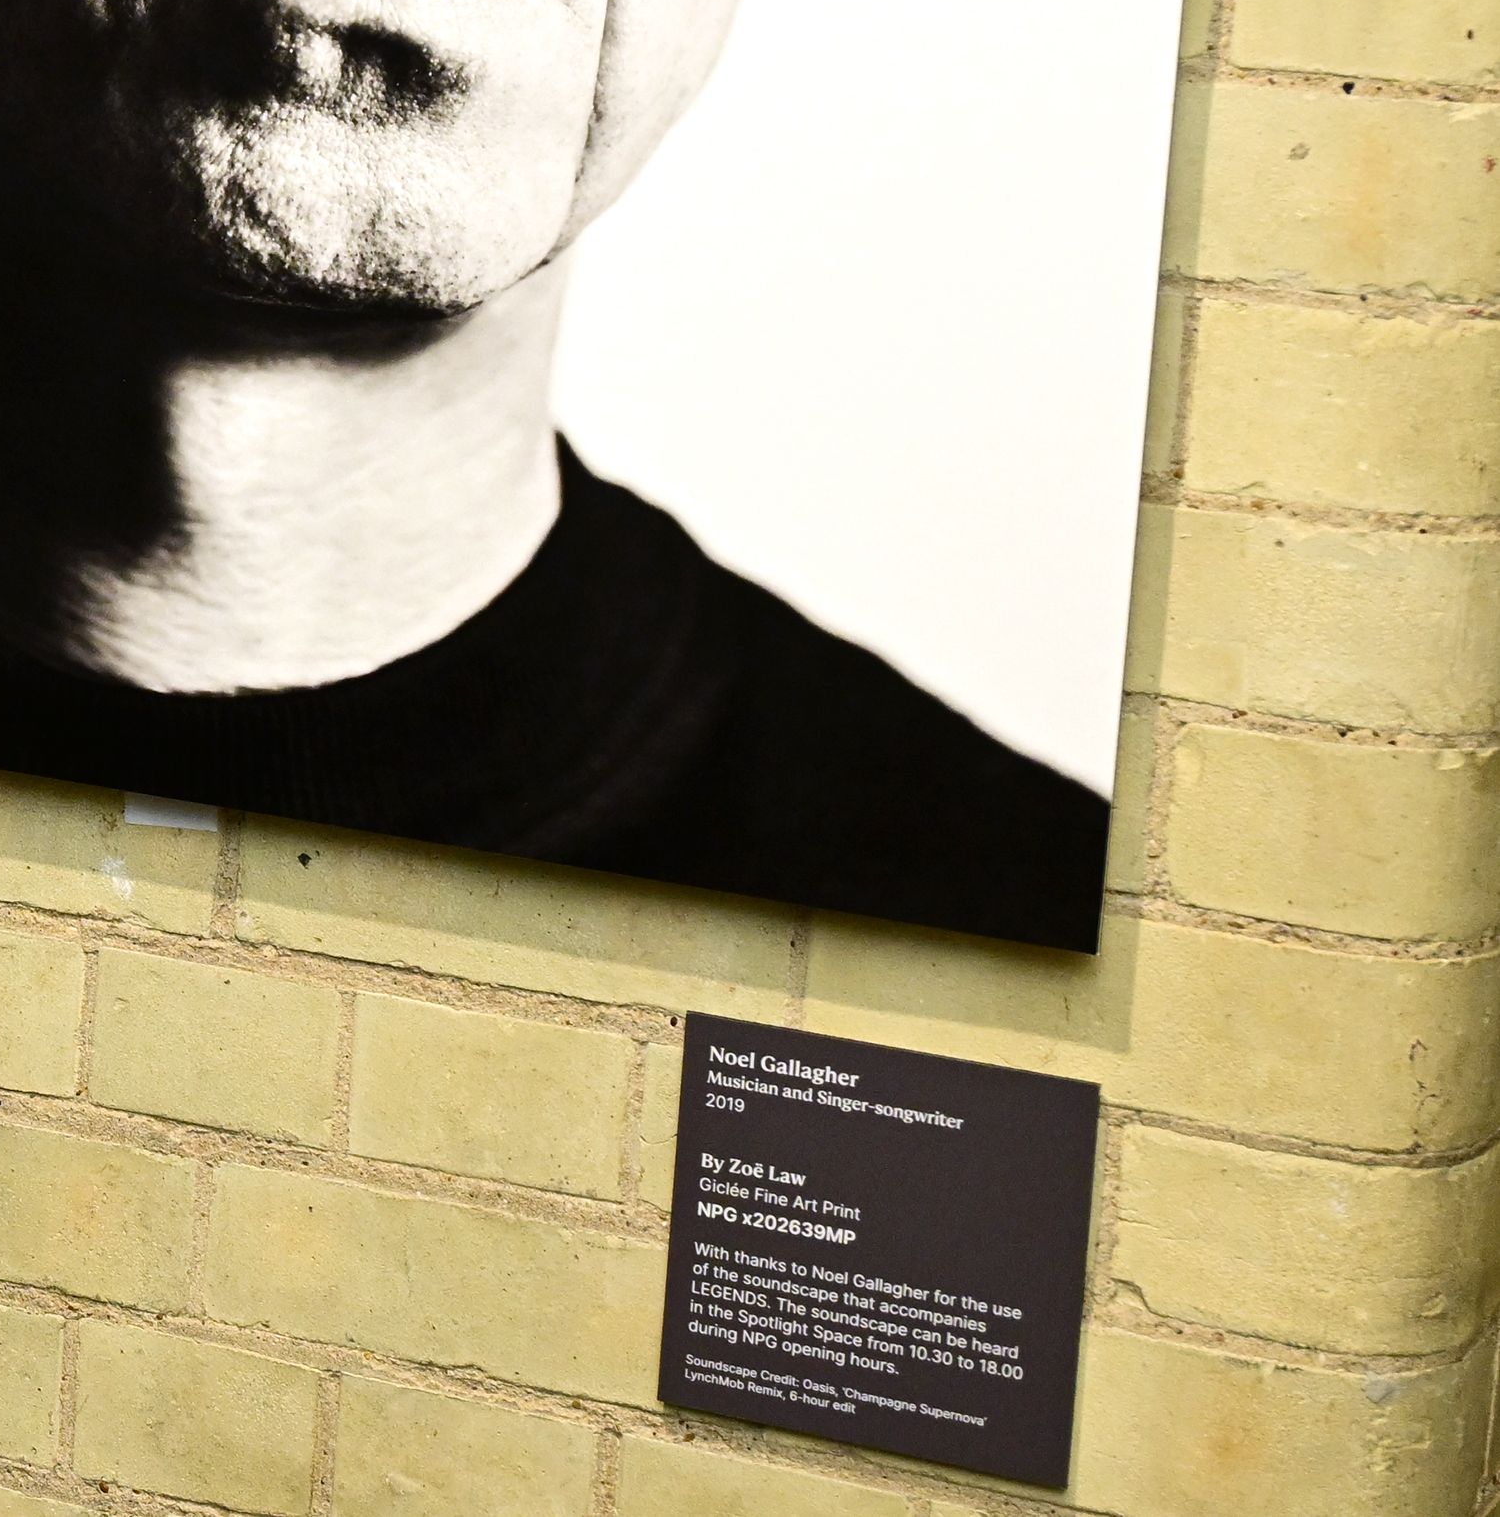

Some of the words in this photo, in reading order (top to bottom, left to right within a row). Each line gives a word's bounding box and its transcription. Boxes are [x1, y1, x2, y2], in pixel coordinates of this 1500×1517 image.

[709, 1046, 755, 1069] Noel
[760, 1055, 860, 1087] Gallagher
[705, 1093, 745, 1113] 2019
[707, 1070, 779, 1096] Musician
[782, 1086, 813, 1102] and
[816, 1090, 964, 1130] Singer-songwriter
[701, 1152, 724, 1173] By
[729, 1158, 764, 1178] Zoë
[768, 1165, 806, 1186] Law
[699, 1177, 750, 1199] Giclée
[754, 1188, 788, 1207] Fine
[793, 1196, 818, 1213] Art
[823, 1200, 861, 1221] Print
[697, 1201, 737, 1222] NPG
[742, 1211, 856, 1245] x202639MP
[693, 1262, 709, 1276] of
[713, 1266, 739, 1282] the
[743, 1274, 839, 1303] soundscape
[843, 1292, 875, 1310] that
[879, 1301, 987, 1332] accompanies
[694, 1241, 730, 1261] With
[734, 1250, 787, 1273] thanks
[791, 1262, 807, 1276] to
[812, 1265, 849, 1285] Noel
[853, 1273, 930, 1301] Gallagher
[934, 1289, 957, 1307] for
[961, 1296, 988, 1313] the
[992, 1304, 1022, 1320] use
[689, 1299, 703, 1314] in
[708, 1303, 733, 1320] the
[738, 1309, 809, 1336] Spotlight
[813, 1325, 863, 1347] Space
[867, 1335, 904, 1356] from
[909, 1344, 953, 1366] 10.30
[957, 1355, 975, 1370] to
[979, 1359, 1023, 1380] 18.00
[691, 1280, 771, 1309] LEGENDS.
[776, 1297, 807, 1316] The
[811, 1307, 908, 1337] soundscape
[912, 1328, 942, 1344] can
[946, 1332, 967, 1349] be
[972, 1337, 1019, 1359] heard
[688, 1320, 738, 1344] during
[742, 1330, 778, 1349] NPG
[782, 1340, 846, 1367] opening
[850, 1352, 899, 1375] hours.
[685, 1354, 757, 1378] Soundscape
[760, 1370, 800, 1388] Credit:
[803, 1378, 838, 1397] Oasis,
[685, 1368, 745, 1390] LynchMob
[747, 1381, 786, 1401] Remix,
[789, 1390, 829, 1408] 6-hour
[832, 1400, 856, 1415] edit
